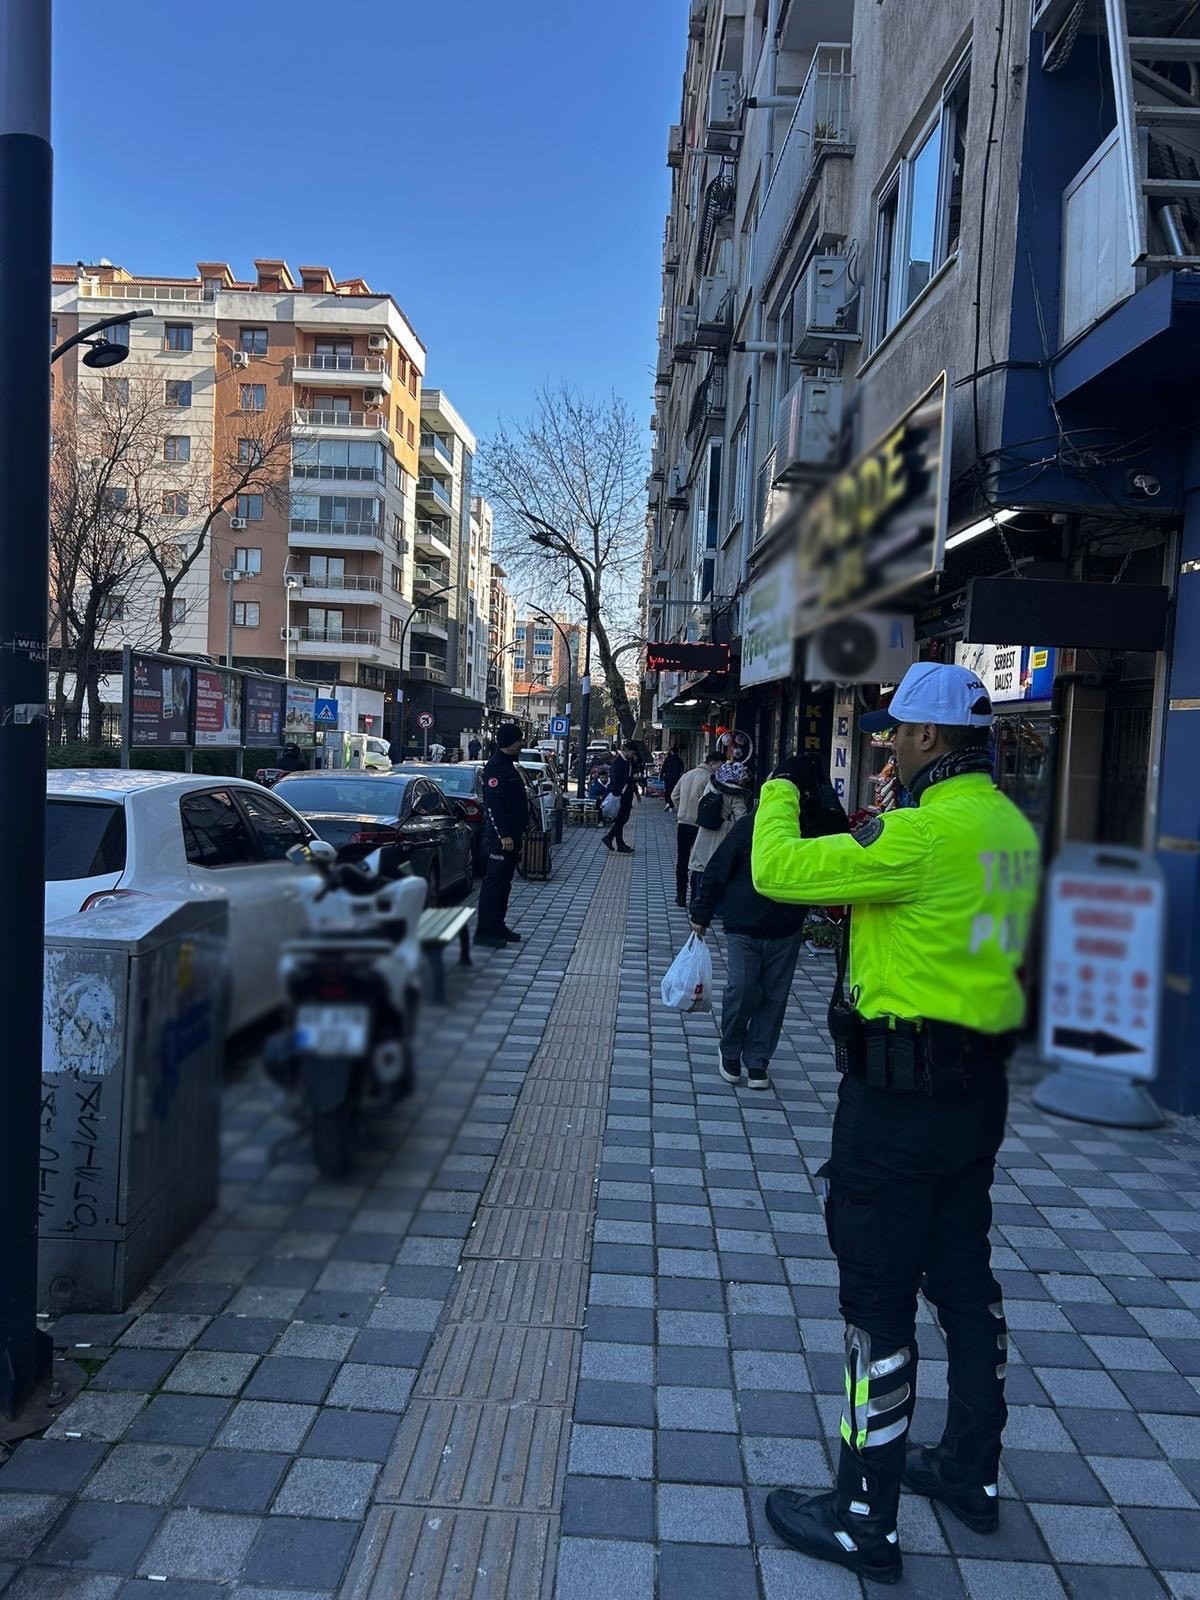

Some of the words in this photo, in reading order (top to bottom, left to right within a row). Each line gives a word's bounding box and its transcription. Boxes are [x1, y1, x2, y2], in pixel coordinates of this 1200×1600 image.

[994, 651, 1016, 671] SERBEST
[555, 721, 564, 731] D
[804, 704, 823, 754] KIR
